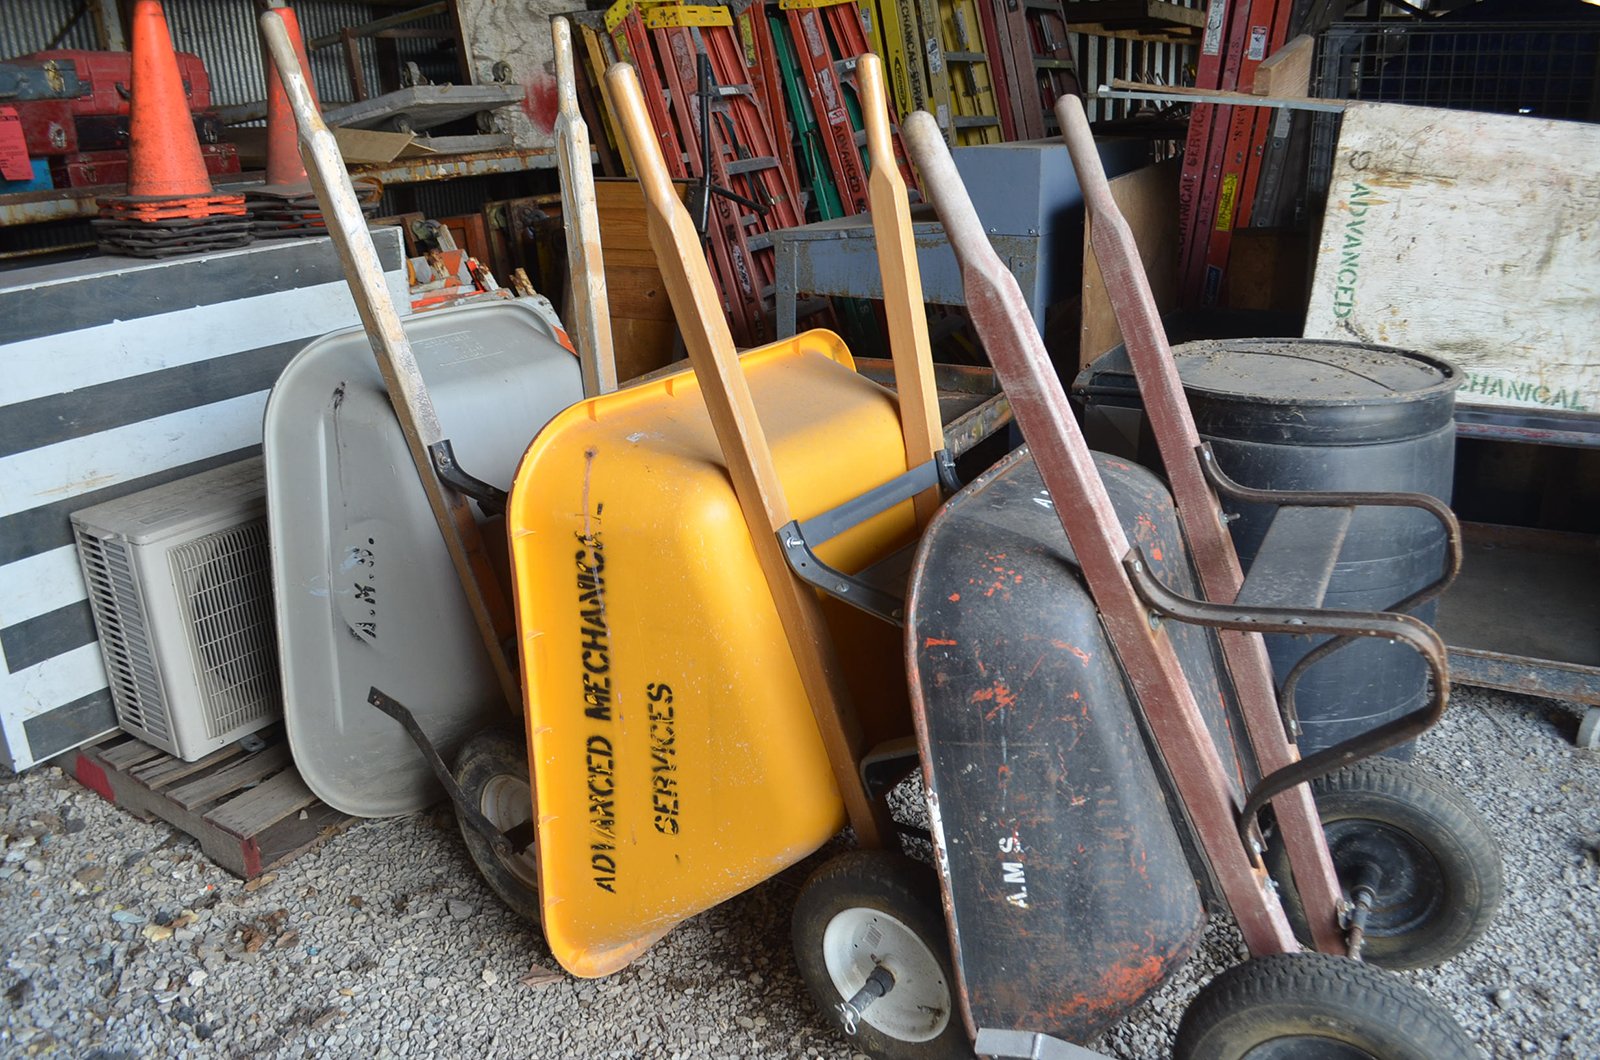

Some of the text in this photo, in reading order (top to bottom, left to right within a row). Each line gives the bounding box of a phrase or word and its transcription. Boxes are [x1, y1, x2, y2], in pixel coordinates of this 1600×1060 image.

[834, 126, 860, 192] ADVANCED
[1333, 183, 1370, 318] ADVANCED
[587, 735, 616, 894] ADVANCED
[647, 683, 679, 835] SERVICES
